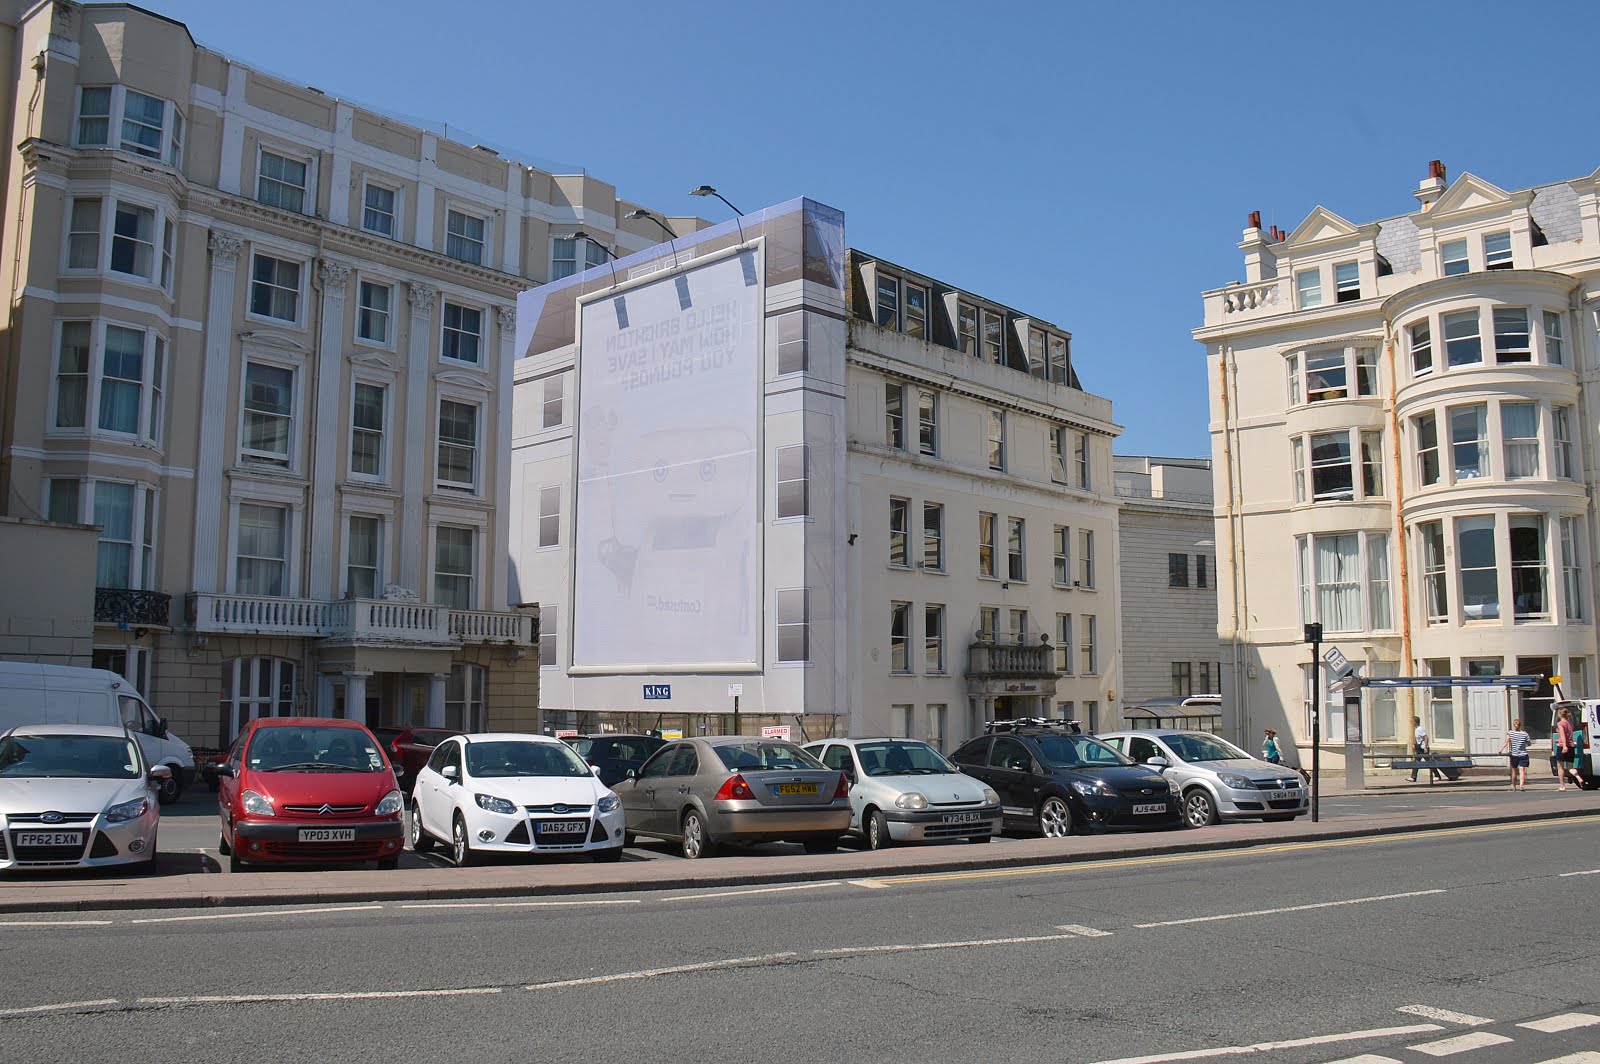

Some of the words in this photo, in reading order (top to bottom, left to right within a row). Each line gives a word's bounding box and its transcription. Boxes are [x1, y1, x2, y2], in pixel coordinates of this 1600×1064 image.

[1333, 658, 1345, 669] TAXI
[645, 686, 669, 696] KING
[1588, 704, 1596, 729] TAXI
[943, 814, 964, 823] W734
[542, 823, 565, 833] DA62
[567, 822, 584, 832] GFX
[21, 834, 52, 844] FP62
[54, 834, 78, 844] EXN
[303, 830, 330, 840] YP03
[332, 830, 351, 840] XVH
